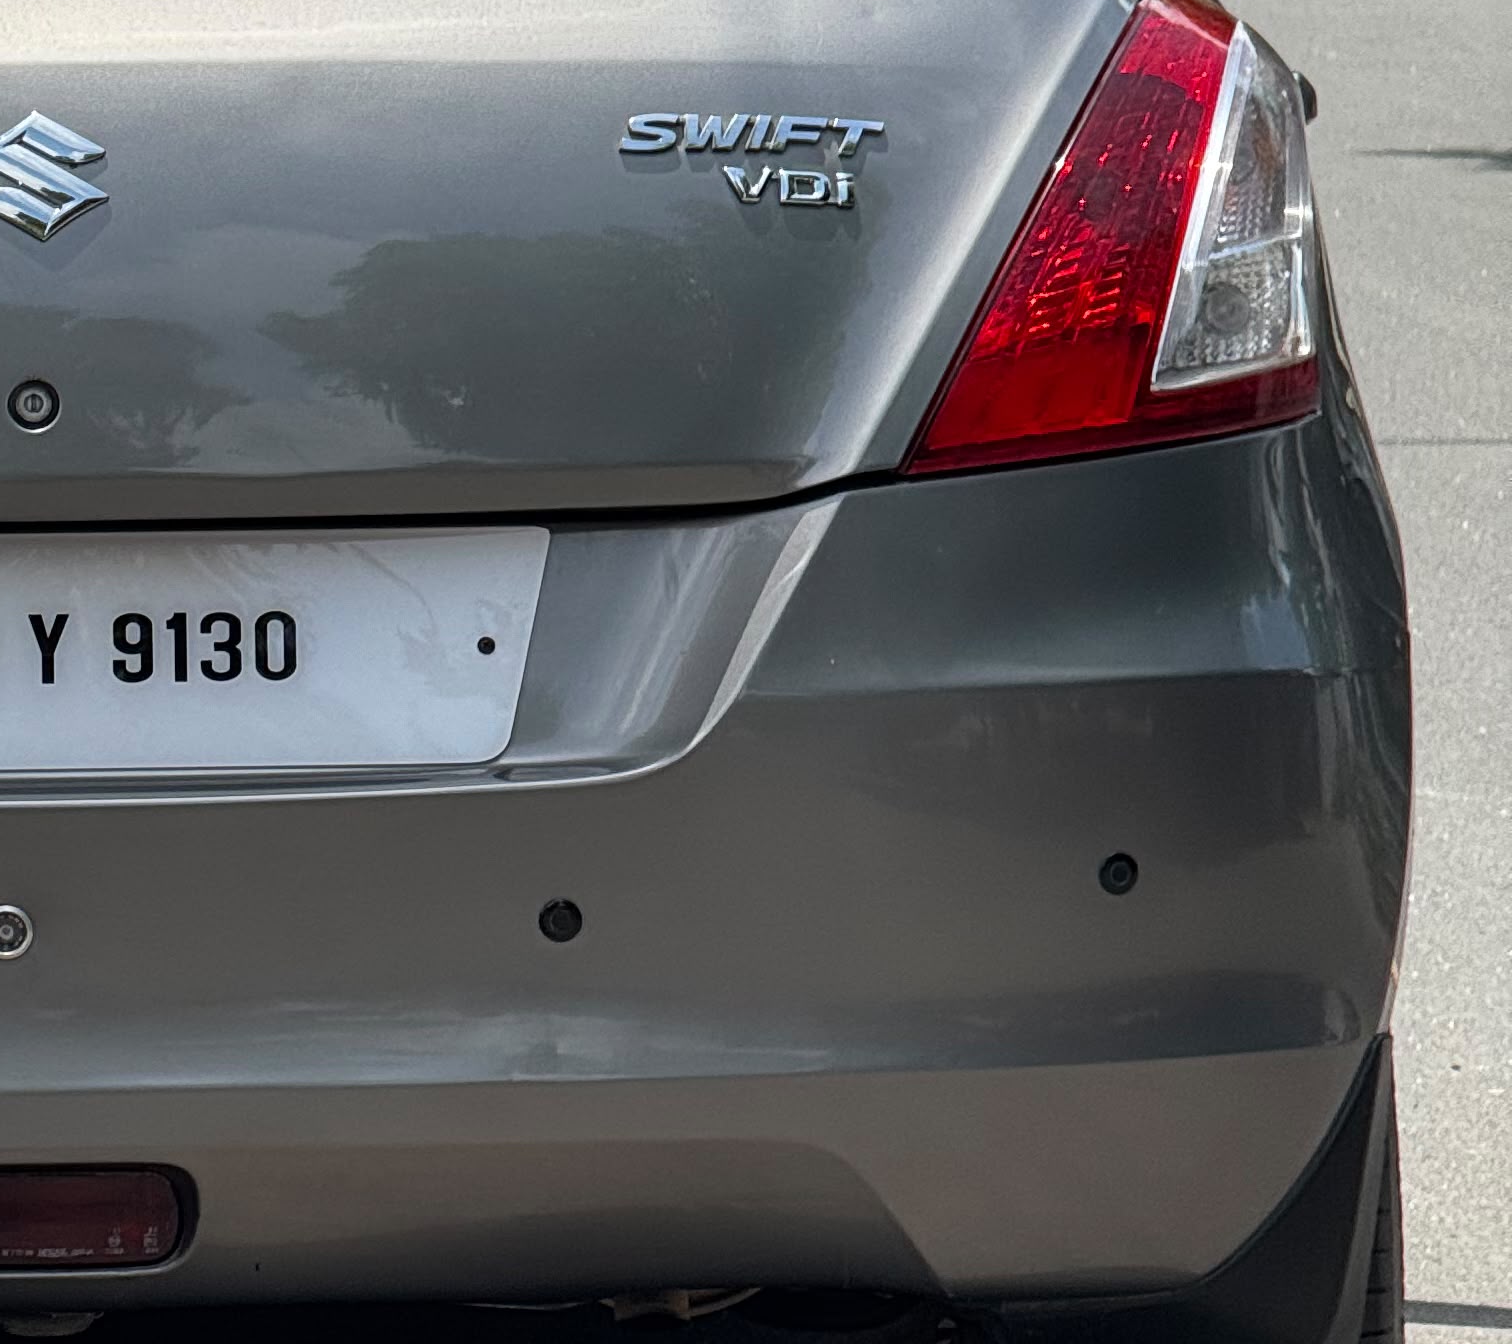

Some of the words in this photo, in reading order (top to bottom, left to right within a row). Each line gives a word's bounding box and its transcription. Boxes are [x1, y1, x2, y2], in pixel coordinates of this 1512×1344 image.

[618, 112, 885, 157] SWIFT
[28, 612, 70, 685] Y
[111, 609, 297, 684] 9130
